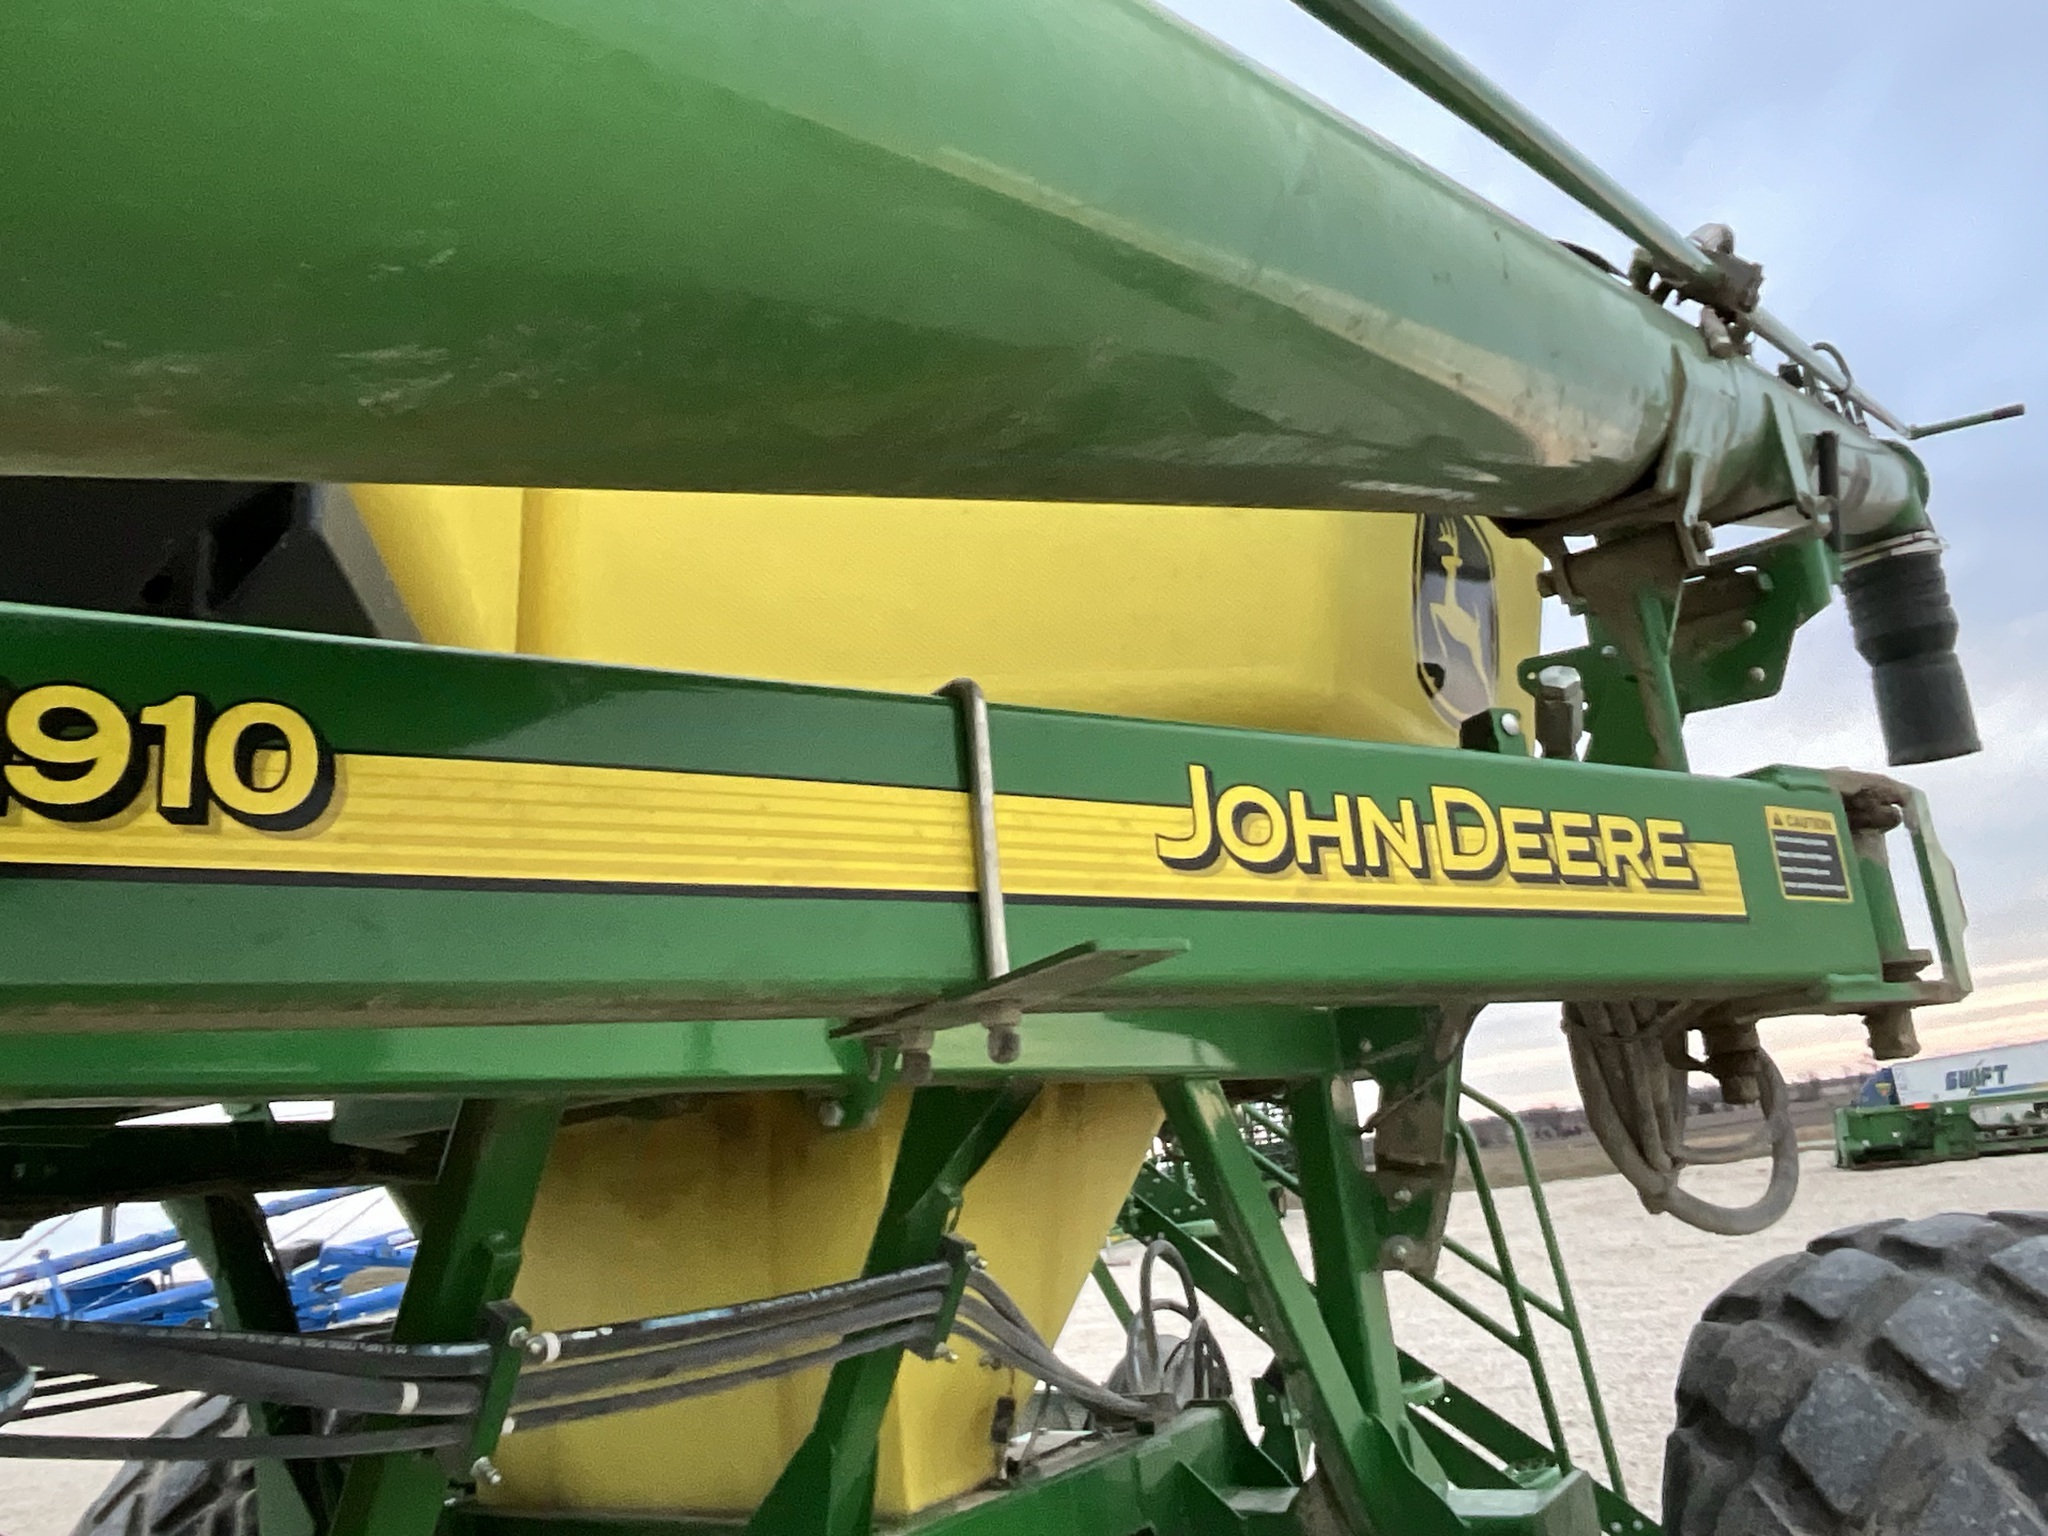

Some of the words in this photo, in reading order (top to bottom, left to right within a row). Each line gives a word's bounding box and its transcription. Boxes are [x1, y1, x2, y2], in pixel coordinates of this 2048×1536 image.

[0, 681, 336, 831] 910
[1155, 763, 1431, 879] JOHN
[1430, 785, 1700, 889] DEERE
[1945, 1064, 2008, 1091] SWIFT
